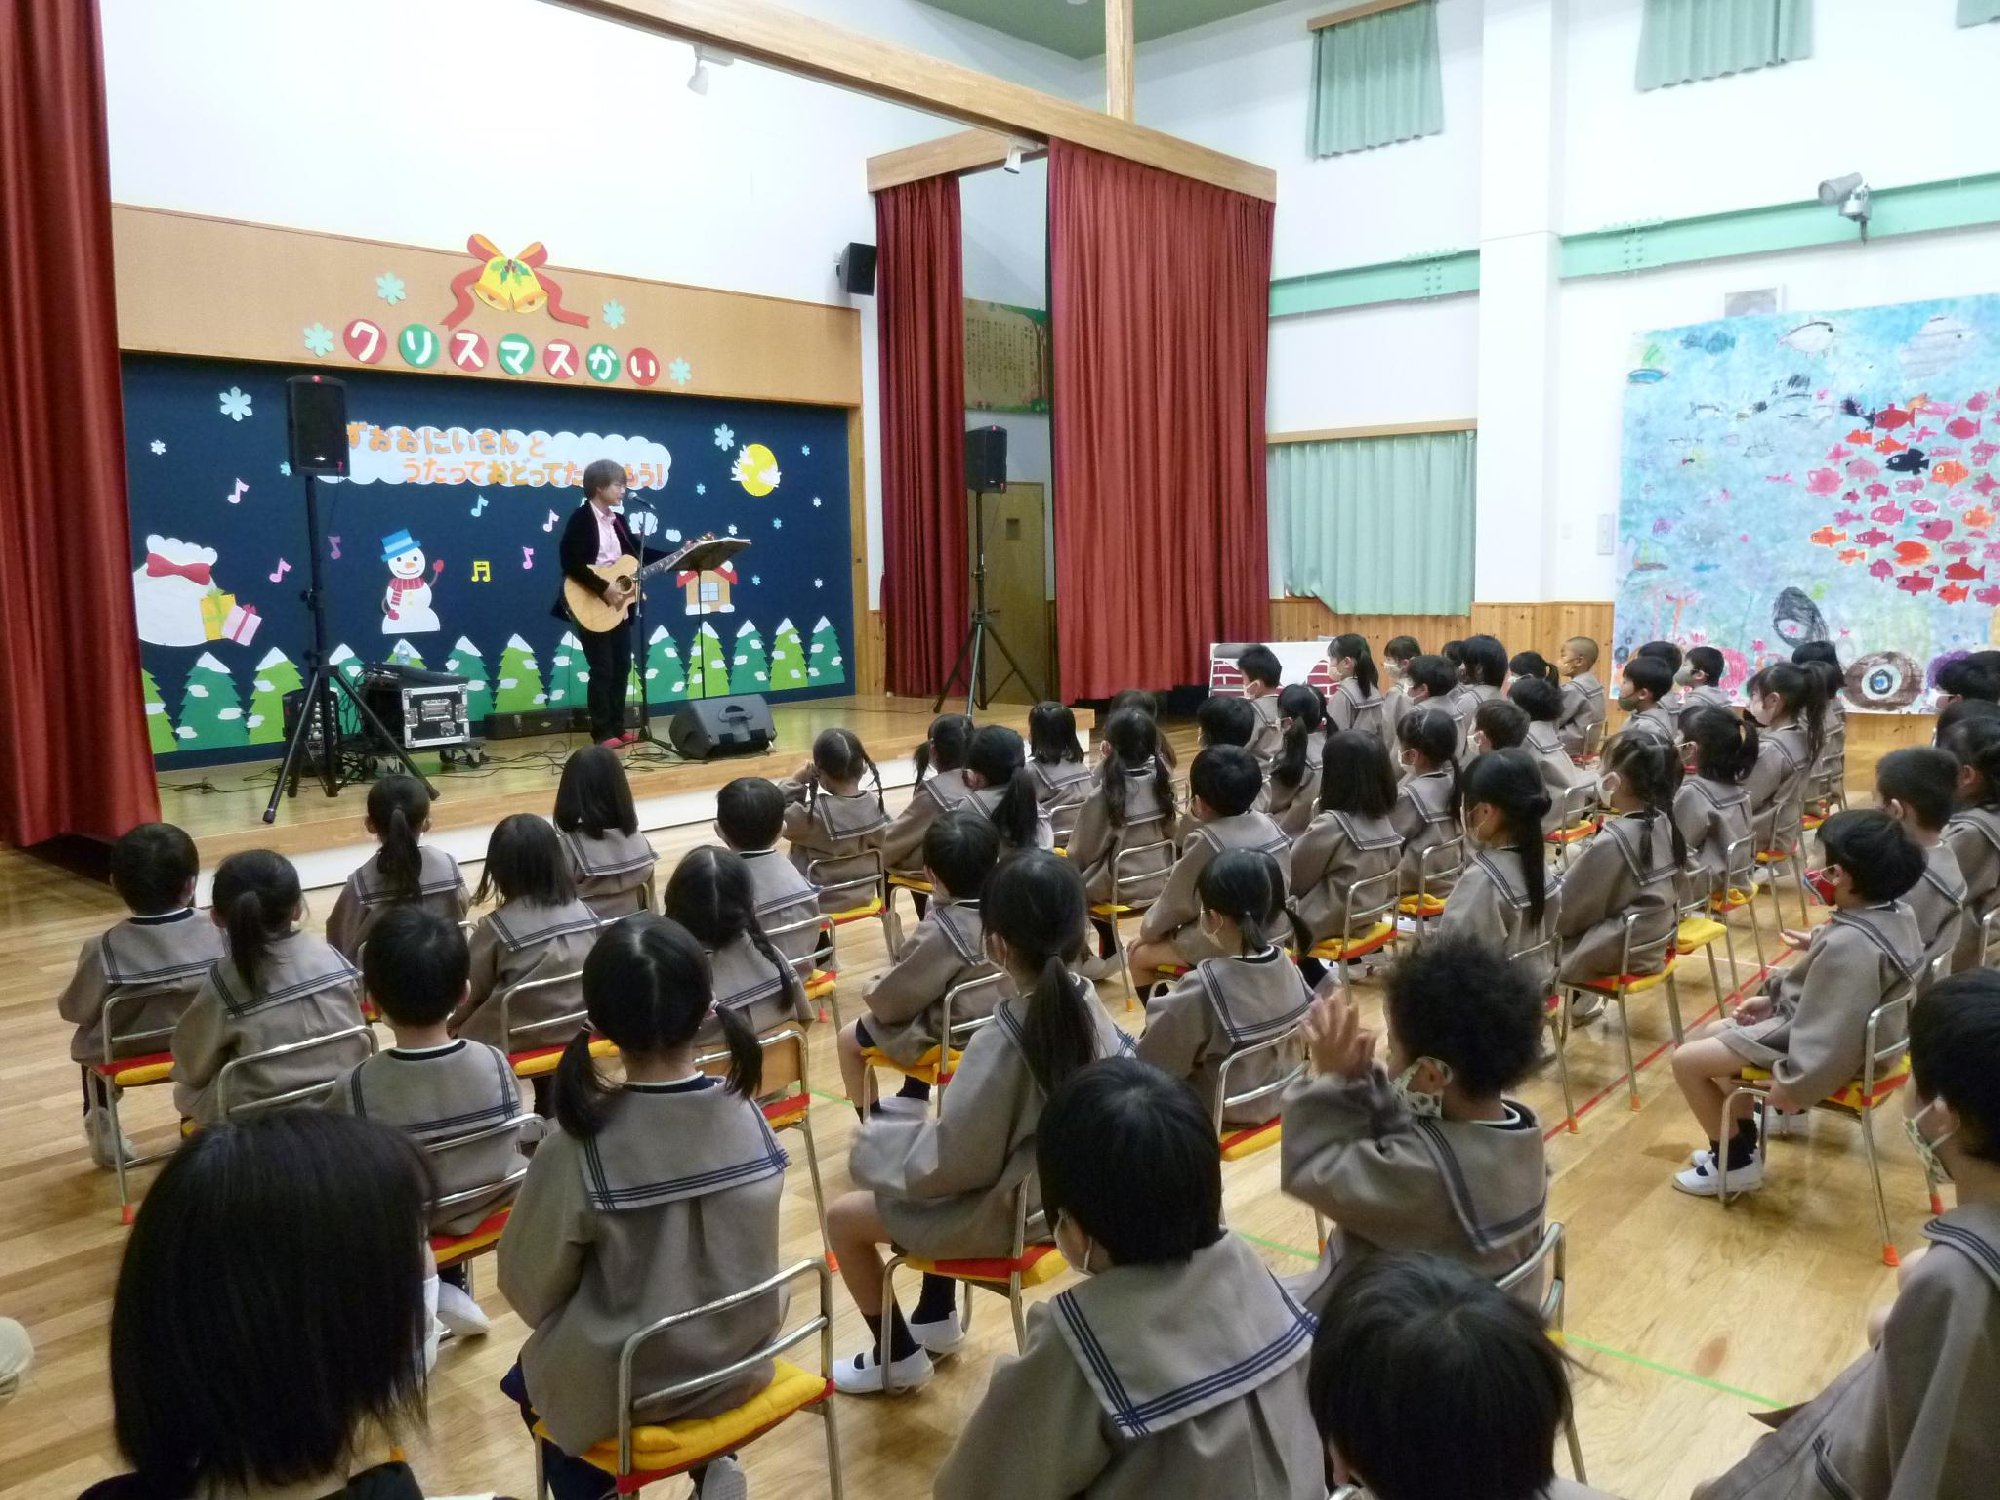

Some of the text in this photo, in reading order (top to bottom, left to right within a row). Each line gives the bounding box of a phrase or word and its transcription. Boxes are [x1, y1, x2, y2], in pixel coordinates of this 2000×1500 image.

[350, 323, 656, 381] クリスマスかい
